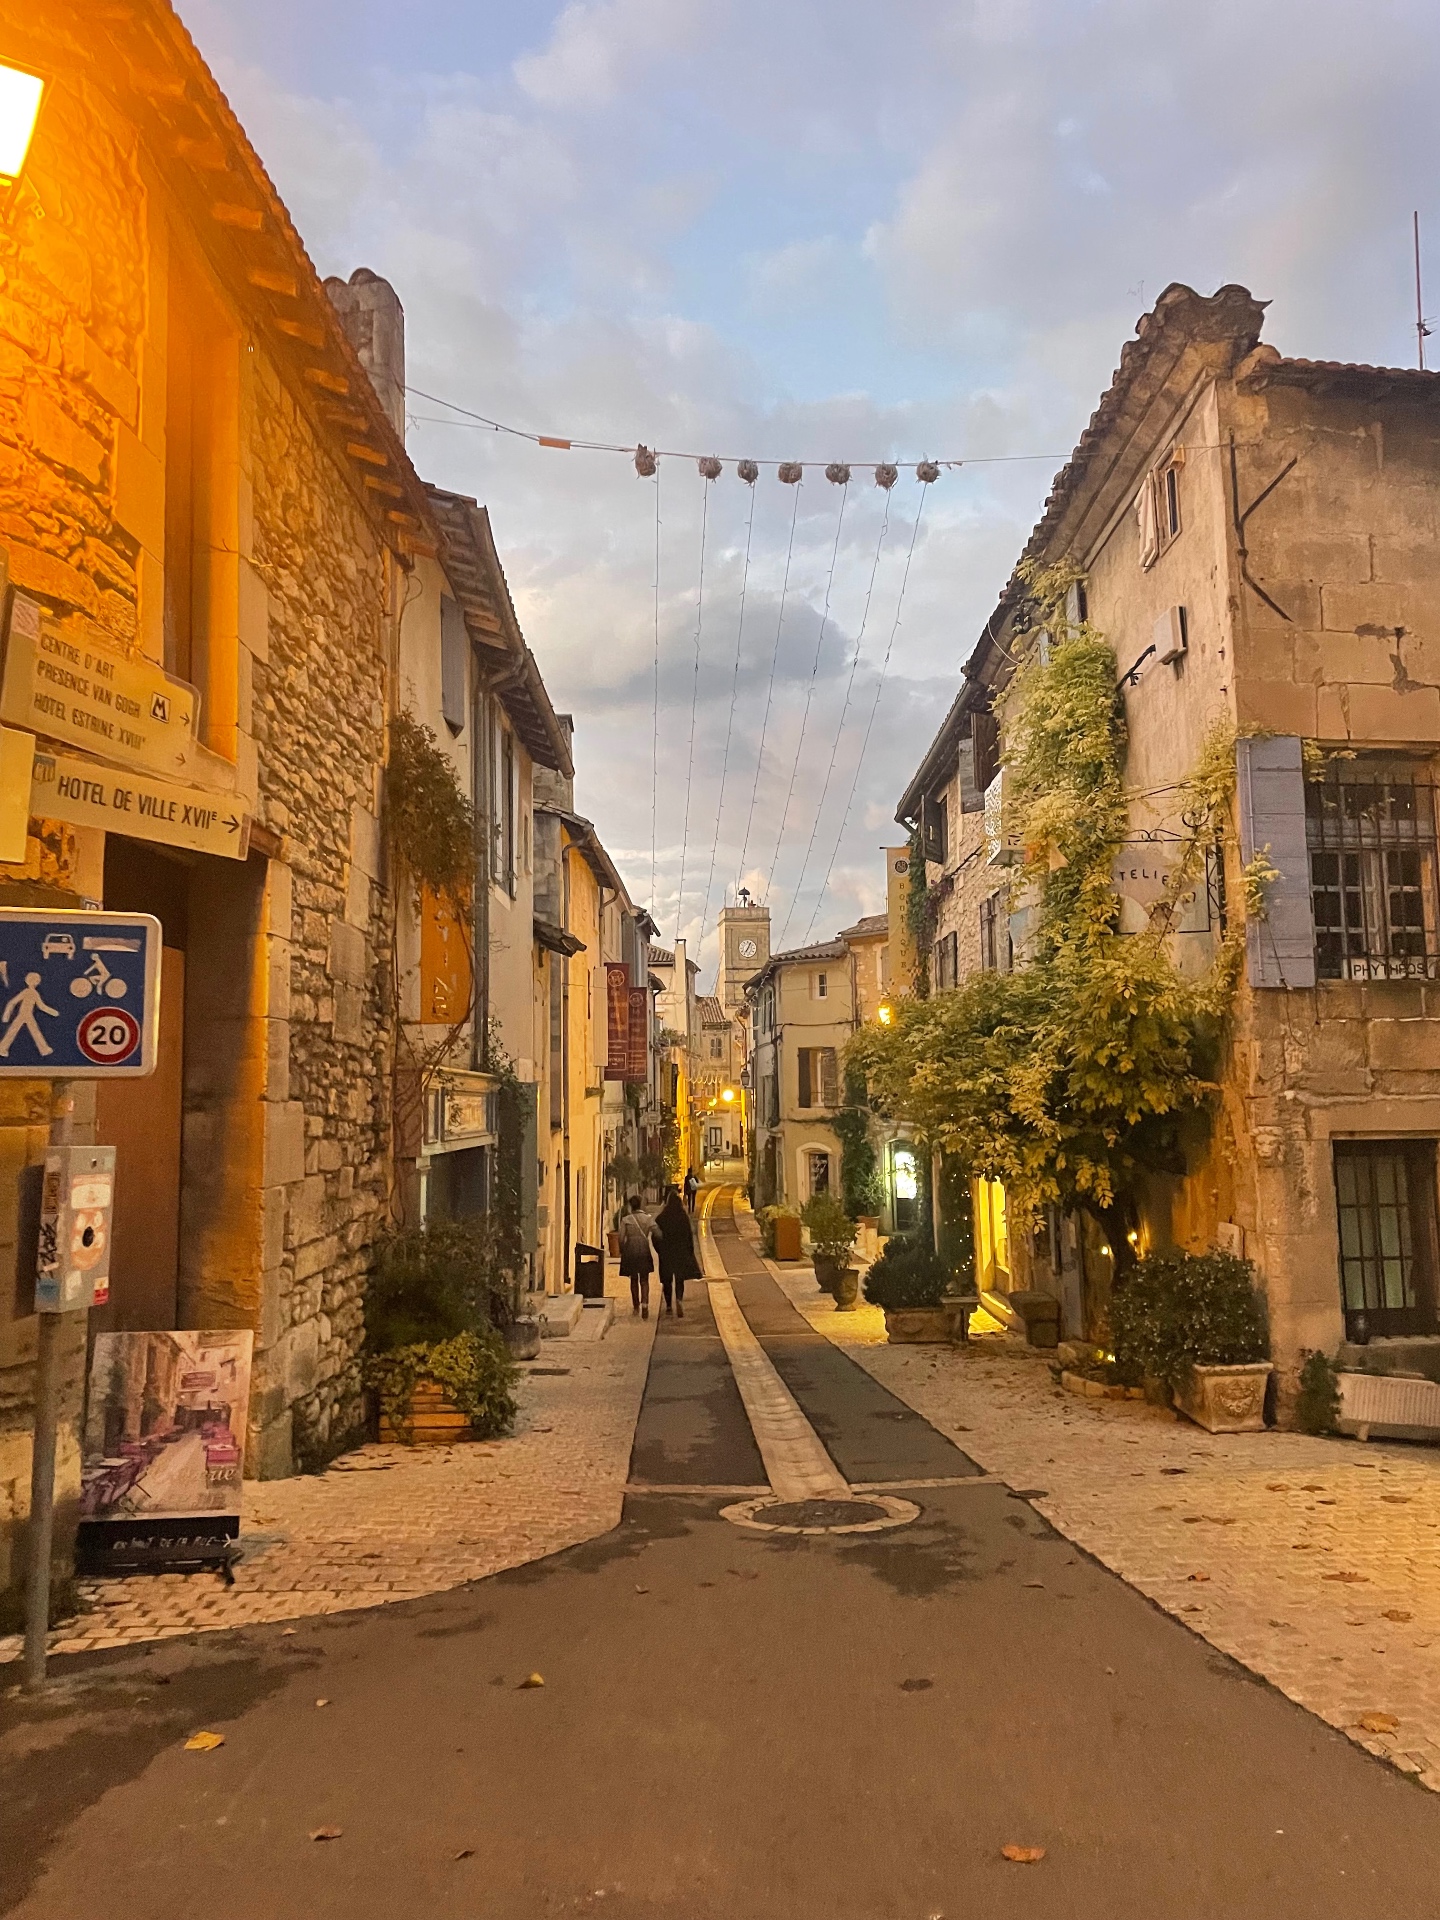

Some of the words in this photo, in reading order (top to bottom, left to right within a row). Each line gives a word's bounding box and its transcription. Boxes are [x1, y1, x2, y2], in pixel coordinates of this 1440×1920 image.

[40, 632, 80, 665] CENTRE
[84, 652, 115, 680] D'ART
[37, 660, 90, 697] PRESENCE
[93, 683, 113, 706] VAN
[115, 694, 141, 718] GOGH
[34, 692, 66, 721] HOTEL
[72, 708, 115, 739] ESTRINE
[57, 775, 107, 806] HOTEL
[113, 788, 132, 812] DE
[138, 793, 176, 822] VILLE
[92, 1025, 126, 1046] 20
